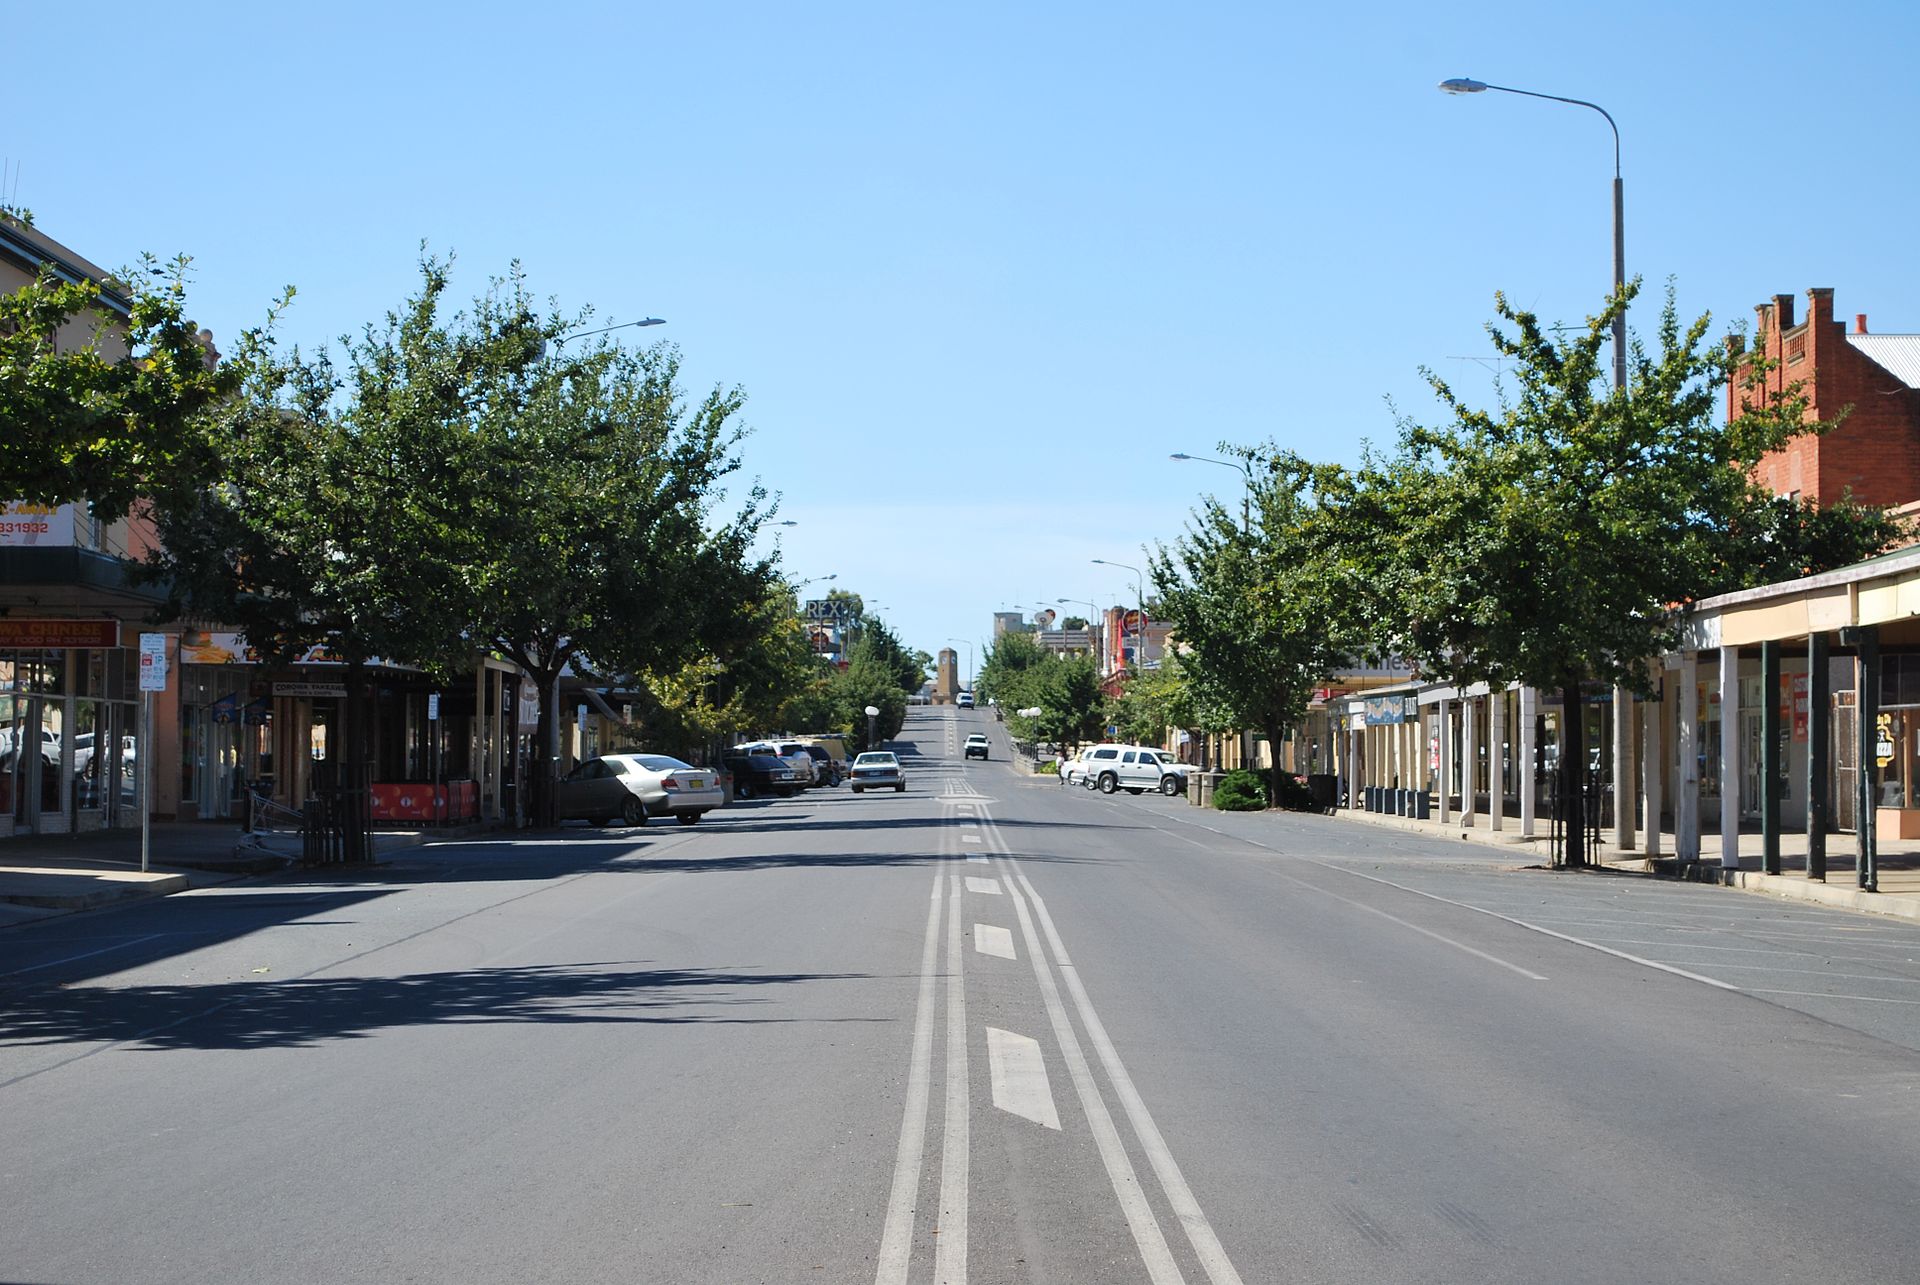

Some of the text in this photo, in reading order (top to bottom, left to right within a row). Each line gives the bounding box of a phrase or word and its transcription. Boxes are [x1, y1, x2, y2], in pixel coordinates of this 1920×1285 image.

[807, 601, 841, 618] REX
[29, 623, 102, 636] CHINESE
[15, 636, 44, 644] FOOD
